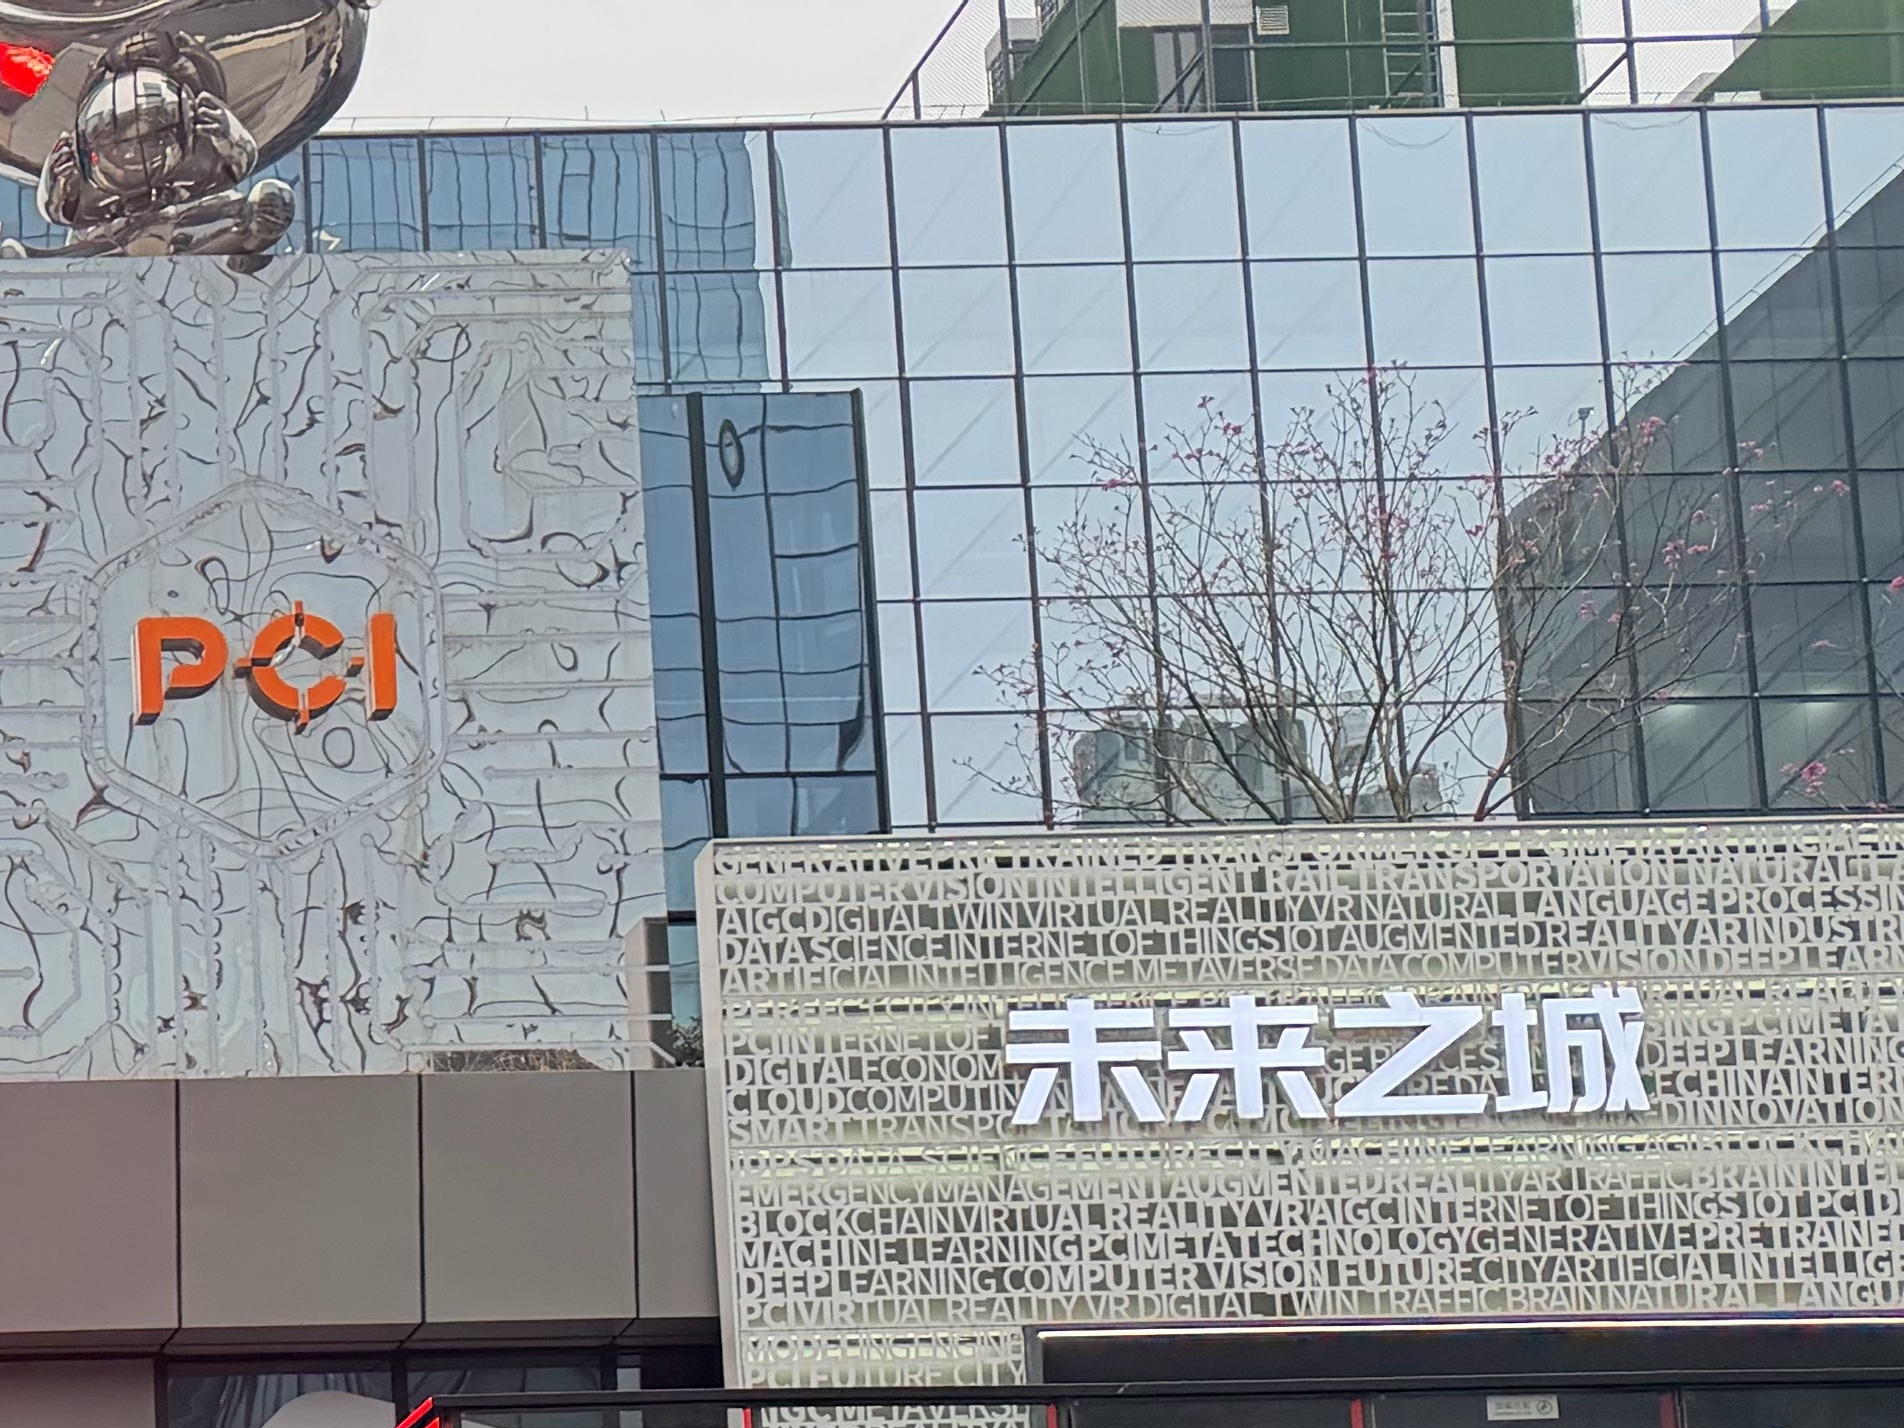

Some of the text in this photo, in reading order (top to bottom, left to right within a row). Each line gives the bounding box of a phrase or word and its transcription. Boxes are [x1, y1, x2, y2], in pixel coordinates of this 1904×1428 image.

[133, 600, 396, 732] PCI
[1005, 984, 1650, 1126] 未来之城
